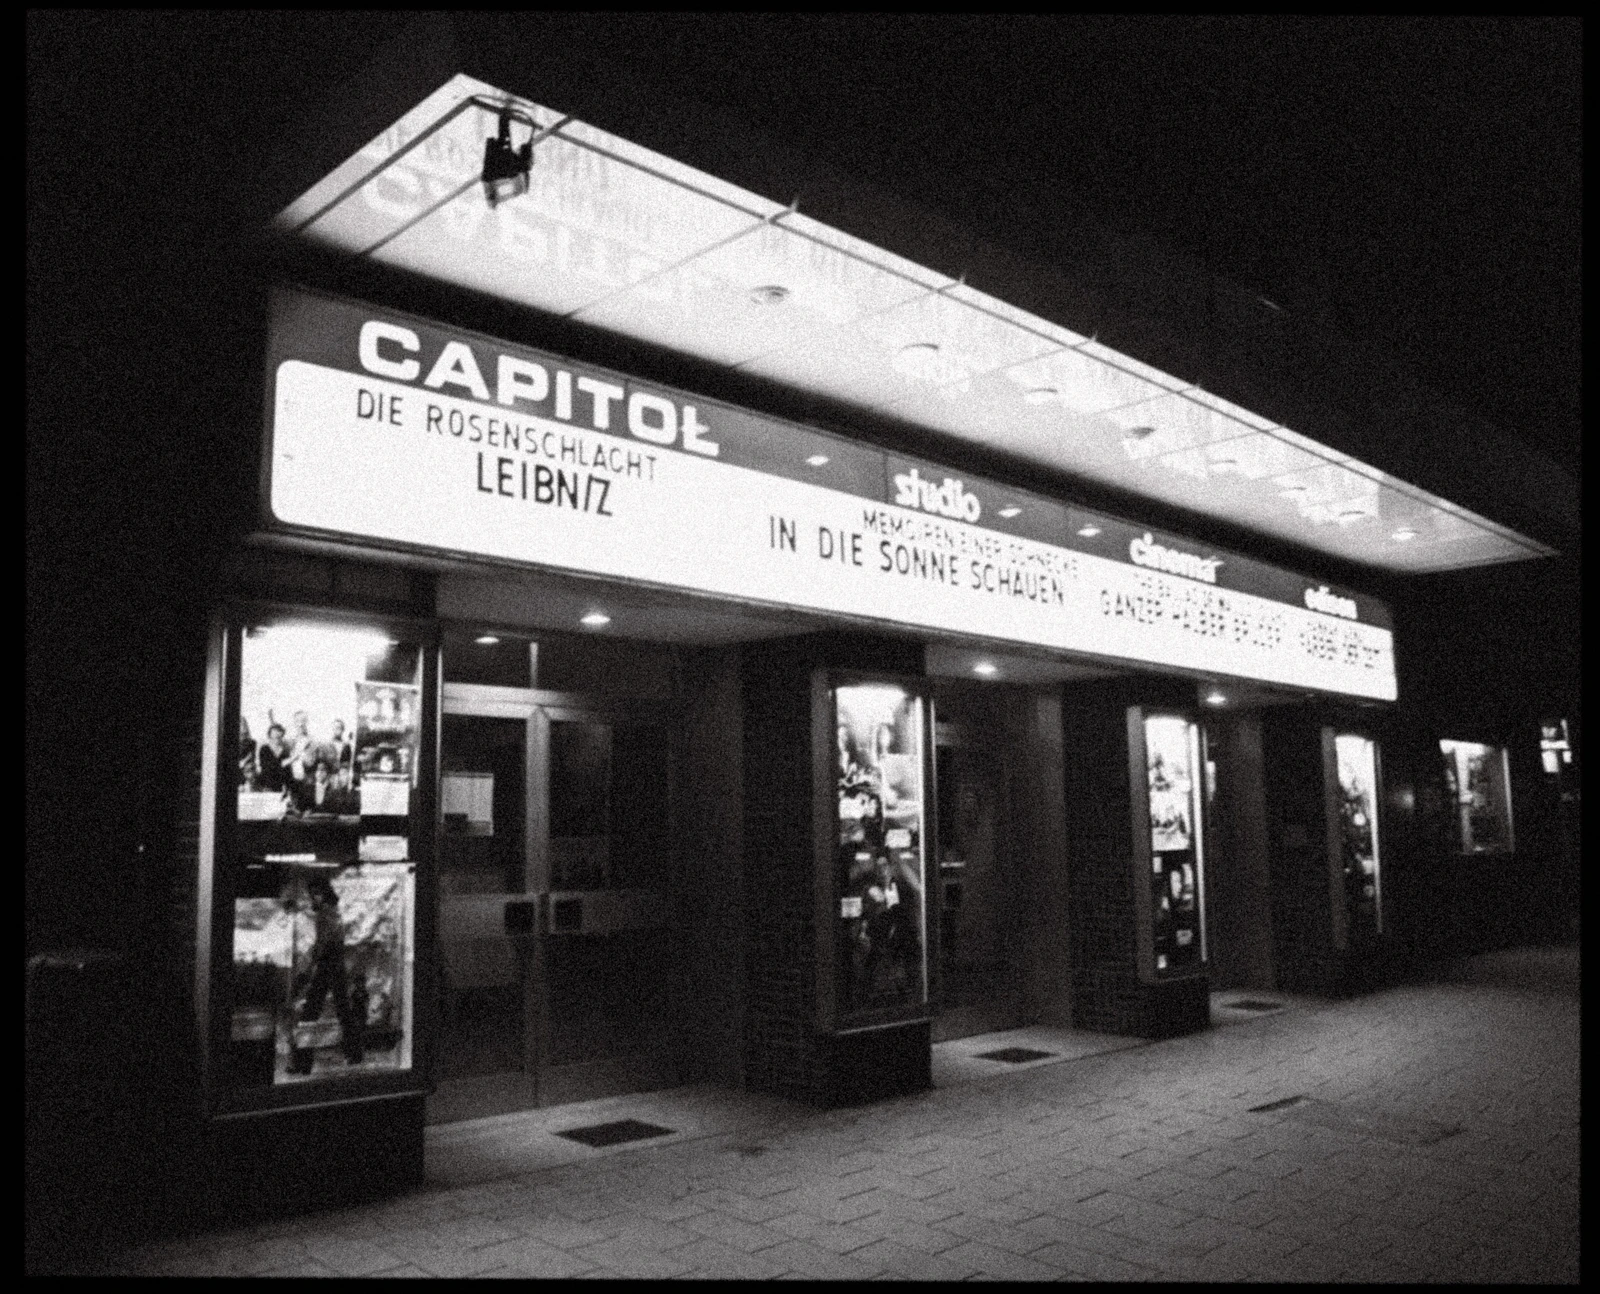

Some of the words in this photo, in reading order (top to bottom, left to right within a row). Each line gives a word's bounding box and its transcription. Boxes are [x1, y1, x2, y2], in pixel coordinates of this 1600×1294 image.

[359, 320, 719, 456] CAPITOL
[356, 388, 403, 426] DIE
[425, 404, 657, 481] ROSENSCHLACHT
[476, 452, 614, 517] LEIBNIZ
[895, 469, 981, 522] studio
[769, 515, 798, 553] IN
[818, 526, 864, 568] DIE
[878, 538, 960, 588] SONNE
[969, 559, 1065, 606] SCHAUEN
